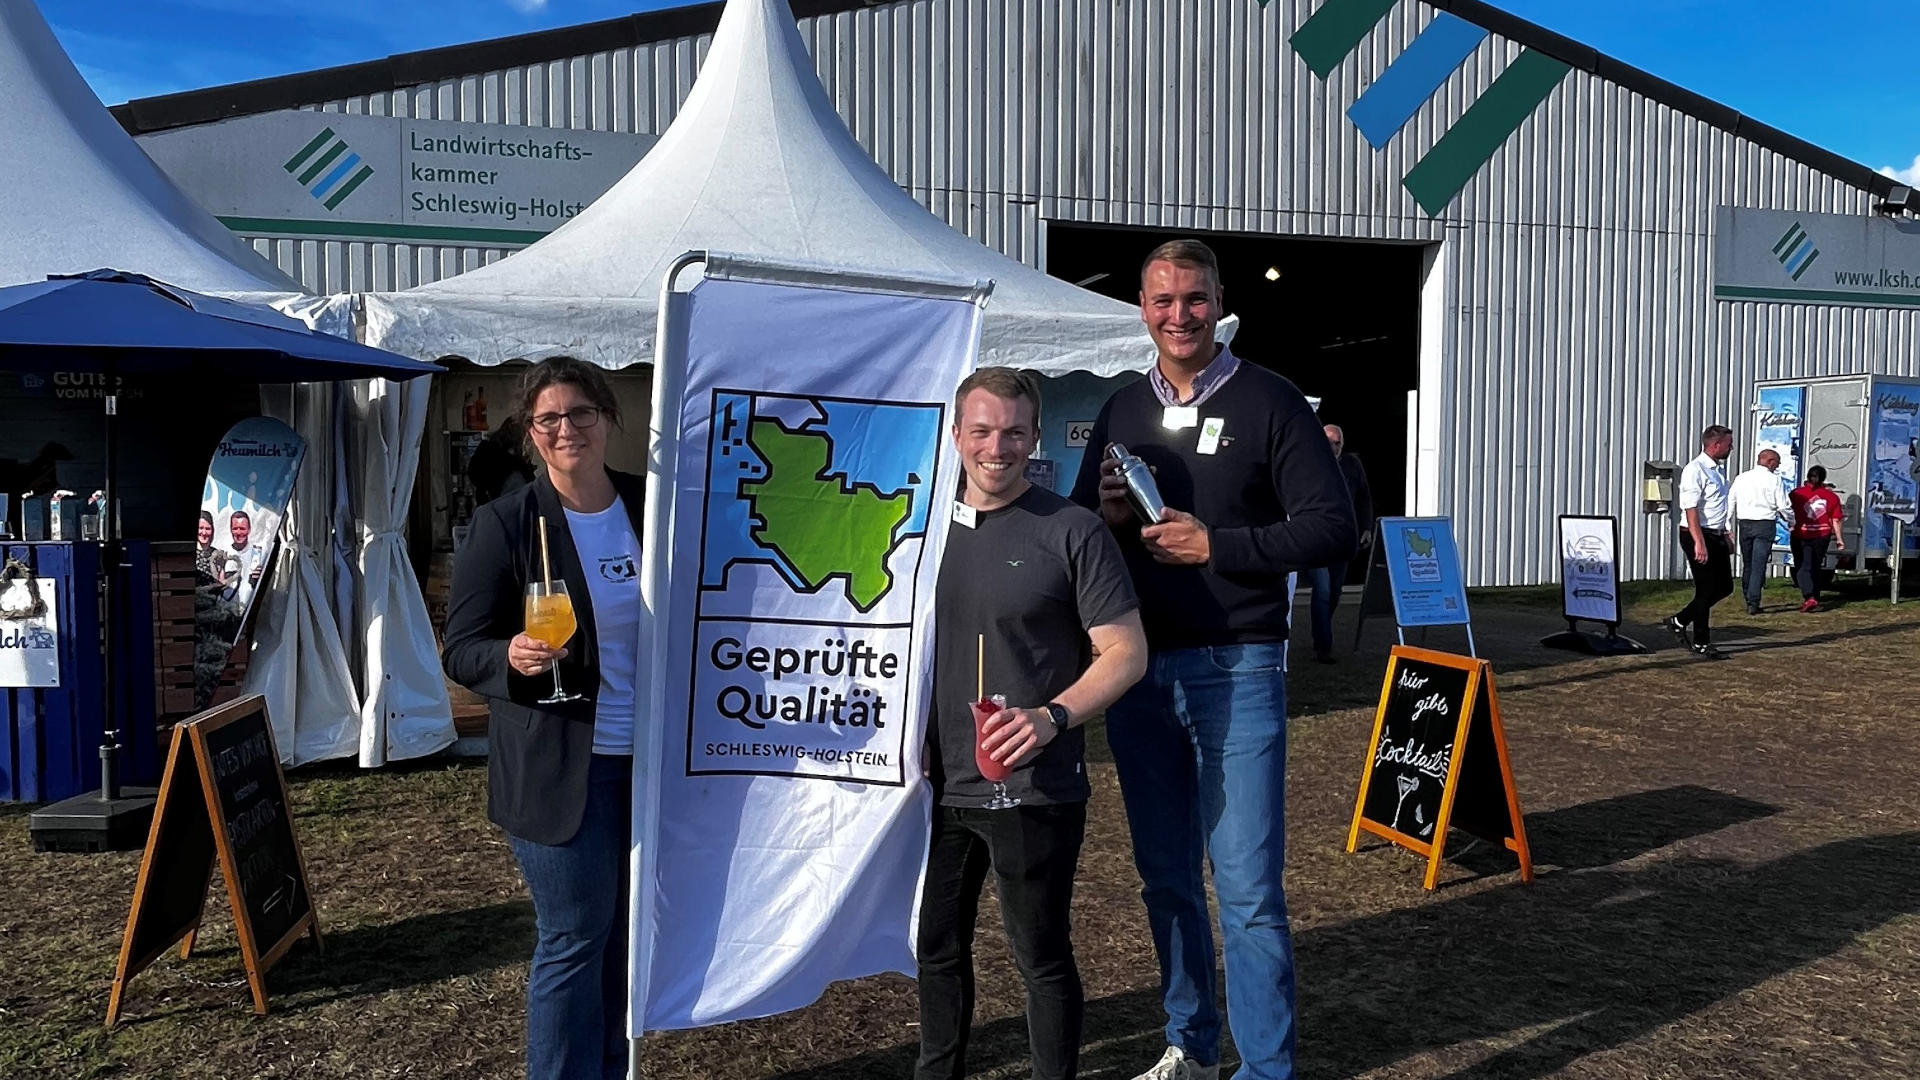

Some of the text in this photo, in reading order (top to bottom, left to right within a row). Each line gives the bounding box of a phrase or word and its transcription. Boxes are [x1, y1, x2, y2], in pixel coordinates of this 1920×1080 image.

[411, 131, 593, 161] Landwirtschafts-
[411, 162, 498, 185] kammer
[219, 442, 282, 457] Heumilch
[710, 637, 898, 680] Geprüfte
[1398, 668, 1429, 690] hier
[716, 685, 887, 729] Qualität
[1412, 693, 1449, 721] gibts
[705, 742, 888, 767] SCHLESWIG-HOLSTEIN
[1379, 737, 1445, 777] Cocktails
